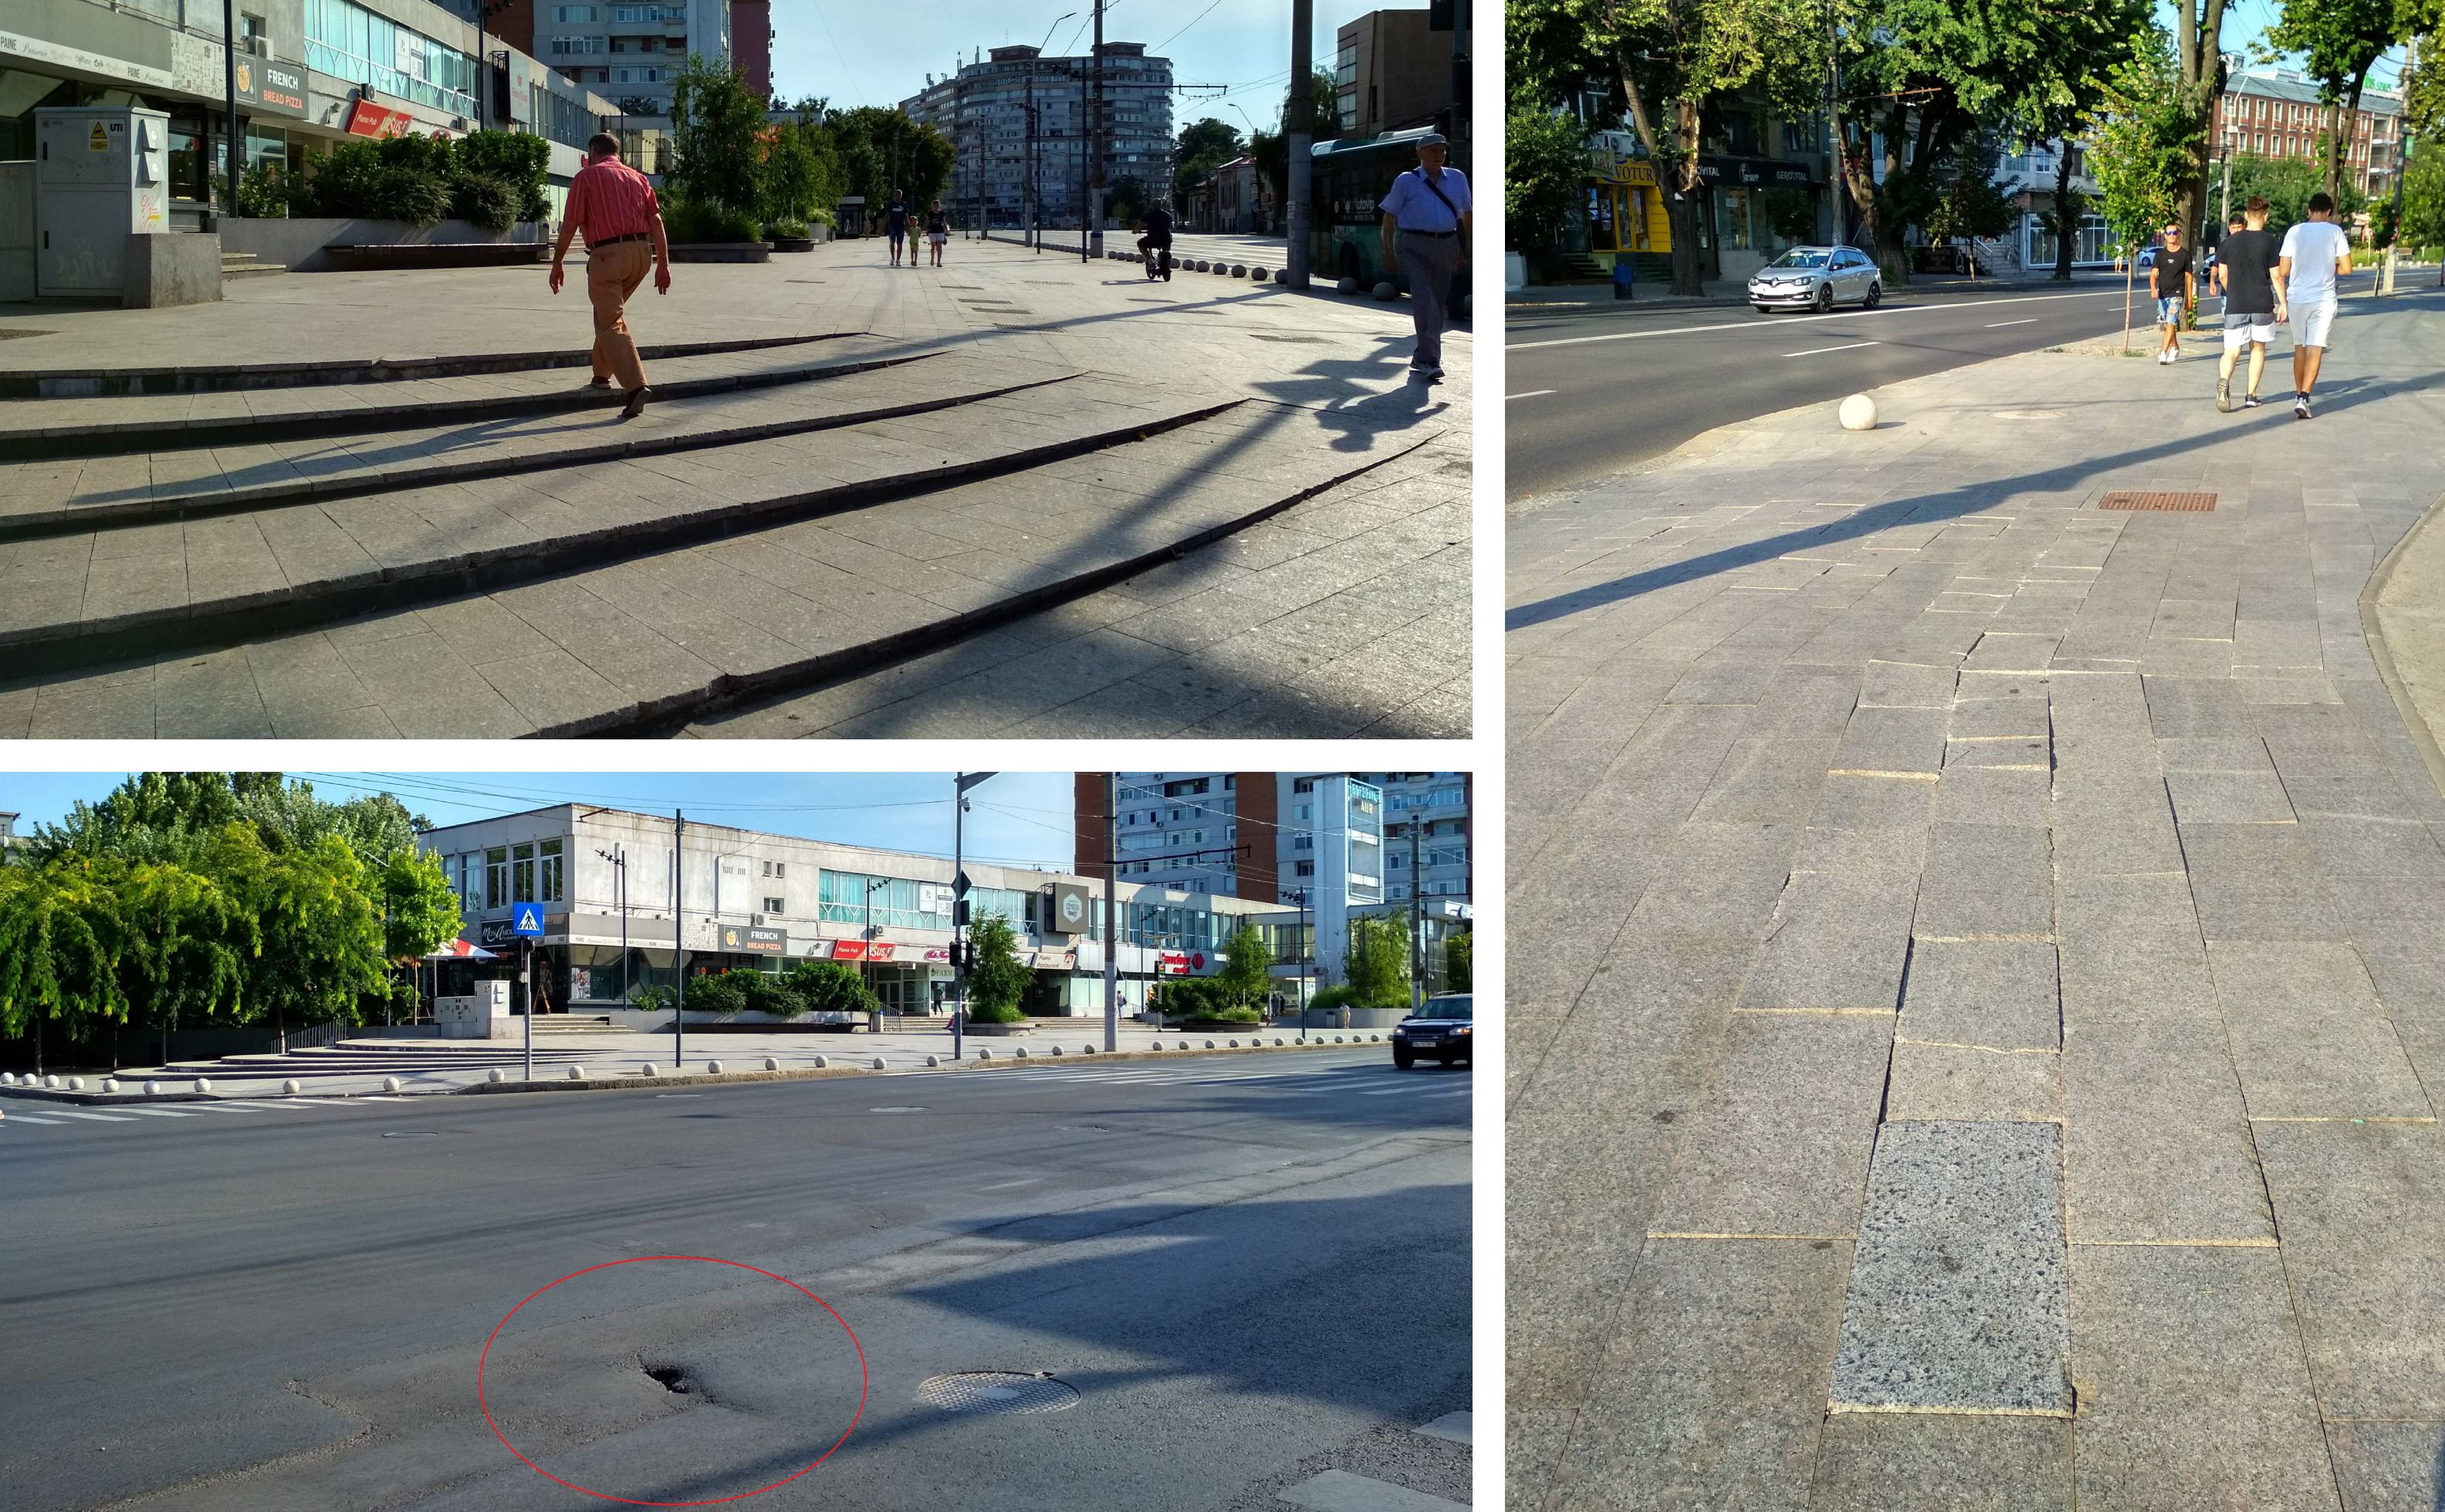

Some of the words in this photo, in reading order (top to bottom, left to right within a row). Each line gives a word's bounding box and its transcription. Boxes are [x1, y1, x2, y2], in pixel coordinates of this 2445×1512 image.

[1, 36, 17, 51] PAINE
[127, 66, 140, 79] PAINE
[267, 69, 299, 90] FRENCH
[263, 90, 285, 105] BREAD
[285, 95, 303, 110] PIZZA
[357, 113, 370, 124] Piano
[369, 117, 377, 126] Pub
[380, 116, 404, 135] URSUS
[1615, 165, 1653, 181] VOTUR
[1776, 171, 1808, 181] GEROVITAL
[1361, 800, 1373, 815] AUR
[751, 931, 778, 940] FRENCH
[864, 945, 885, 958] URSUS
